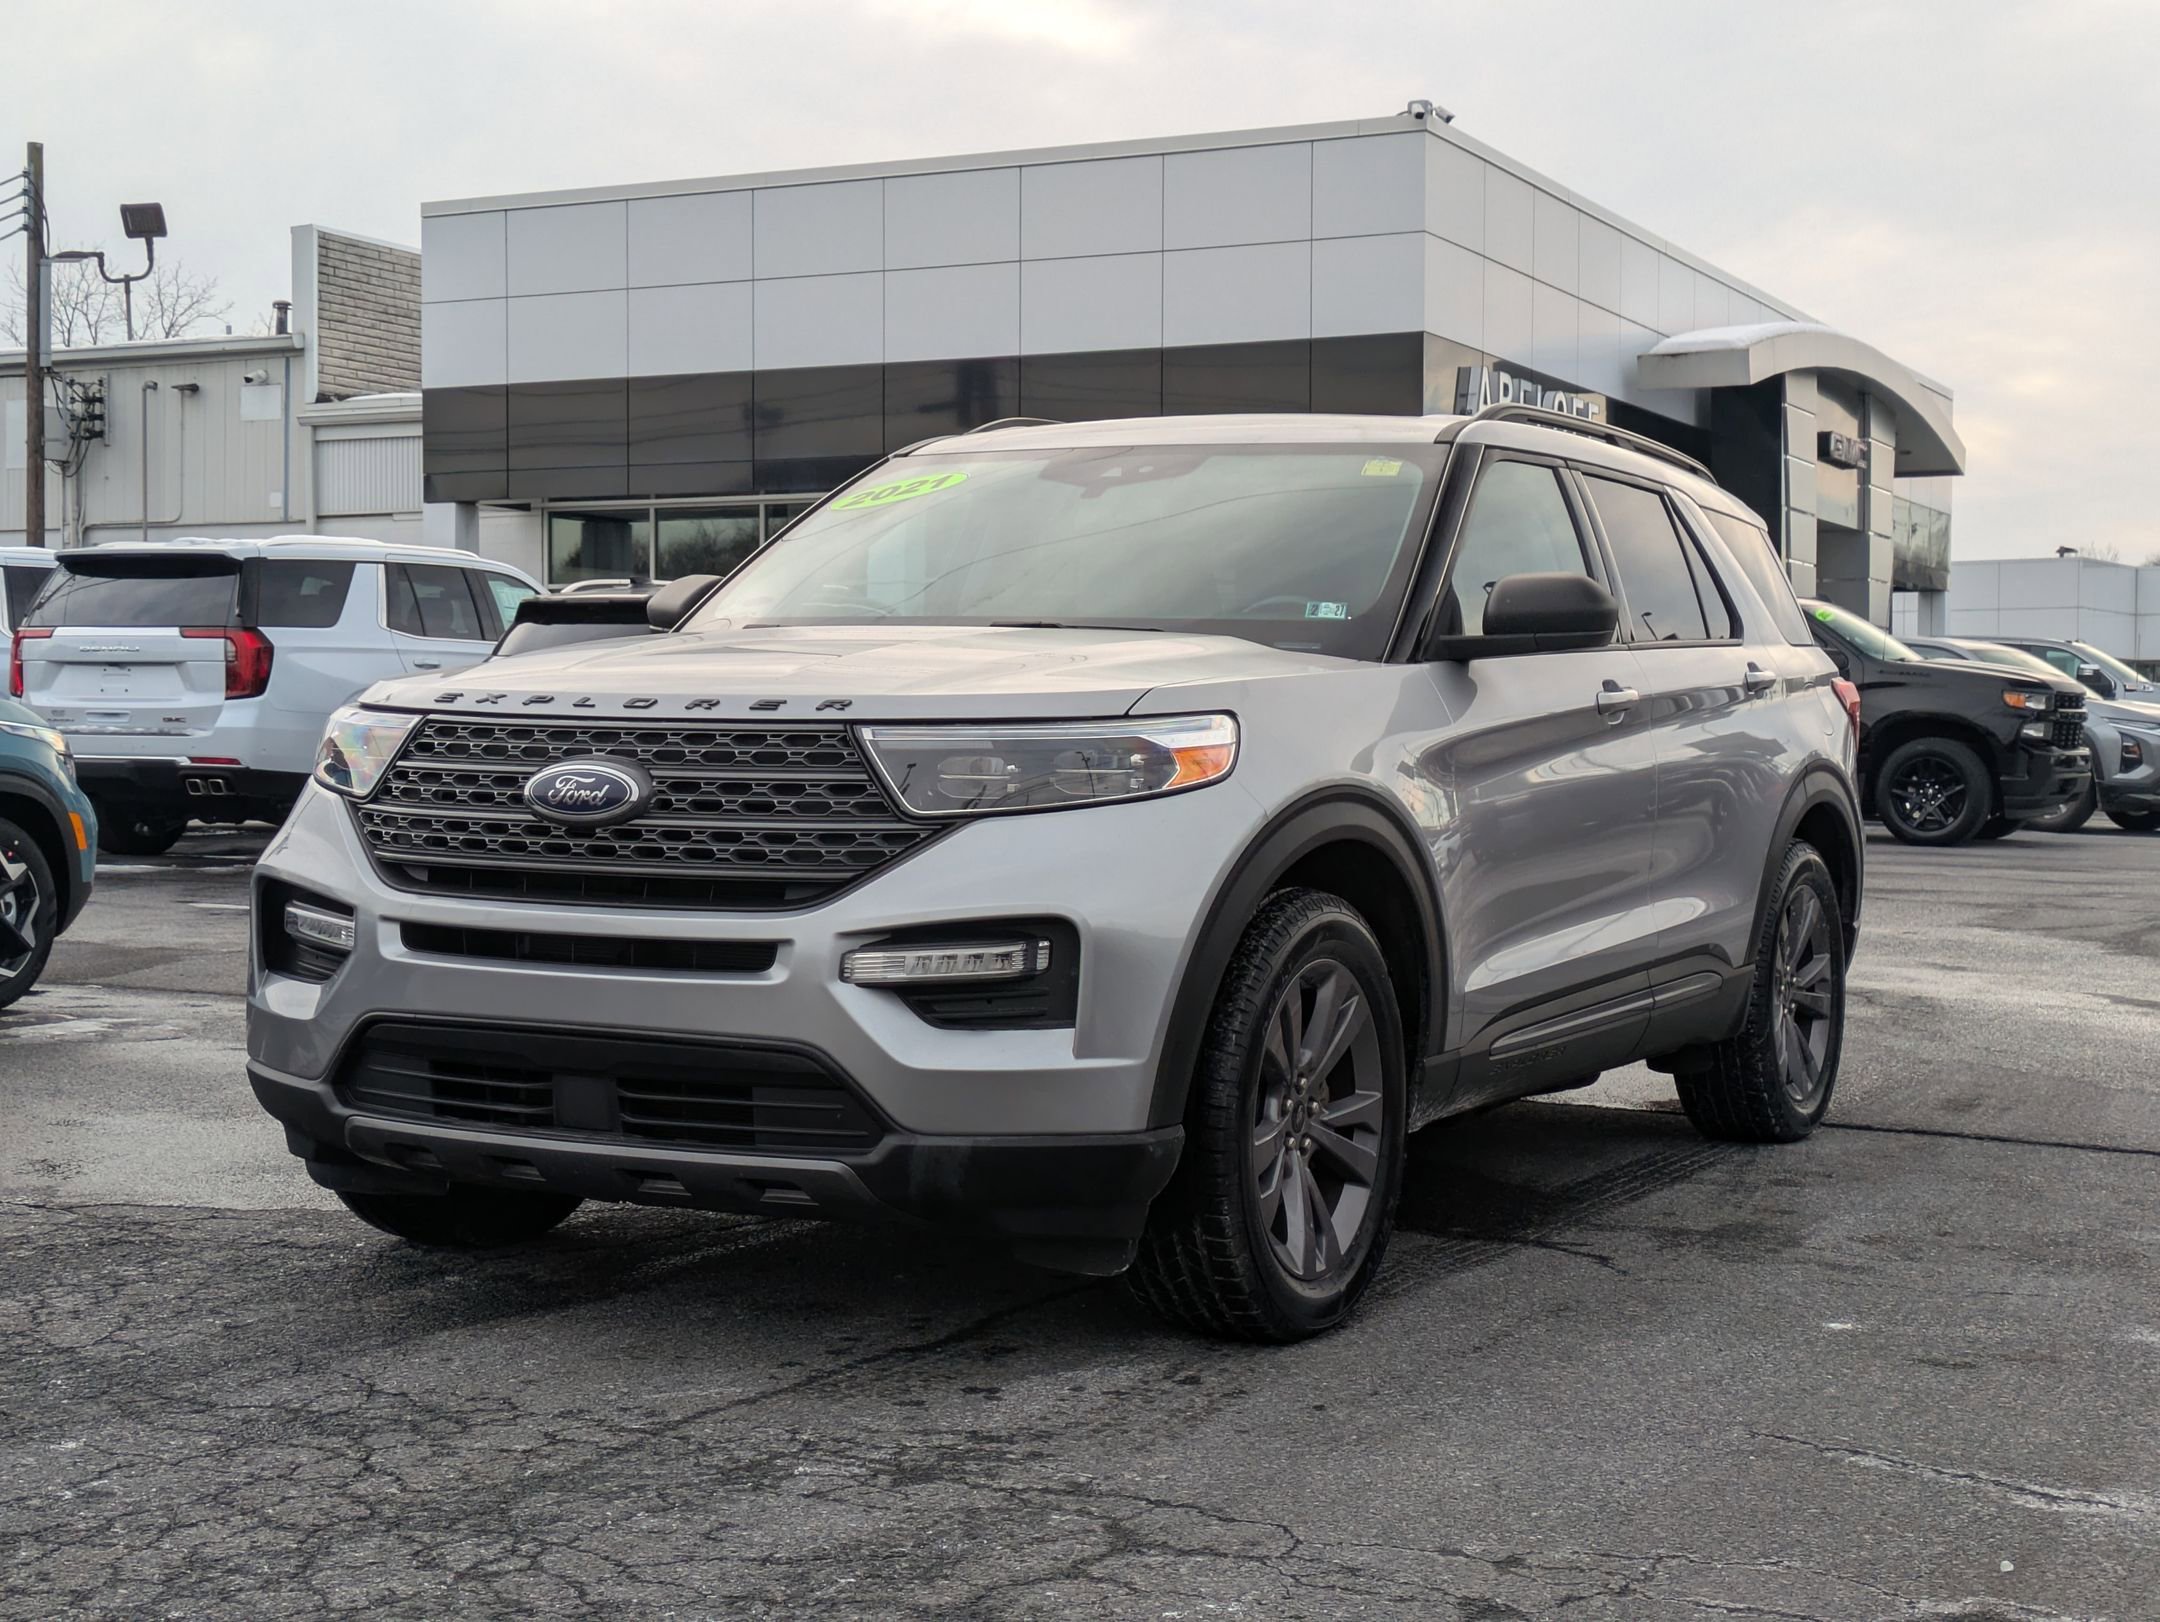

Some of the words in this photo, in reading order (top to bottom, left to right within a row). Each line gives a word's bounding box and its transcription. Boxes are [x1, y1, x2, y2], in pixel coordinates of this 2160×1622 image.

[839, 474, 953, 508] 2021
[1334, 604, 1345, 617] 27
[433, 692, 853, 712] EXPLORER
[548, 774, 606, 807] Ford
